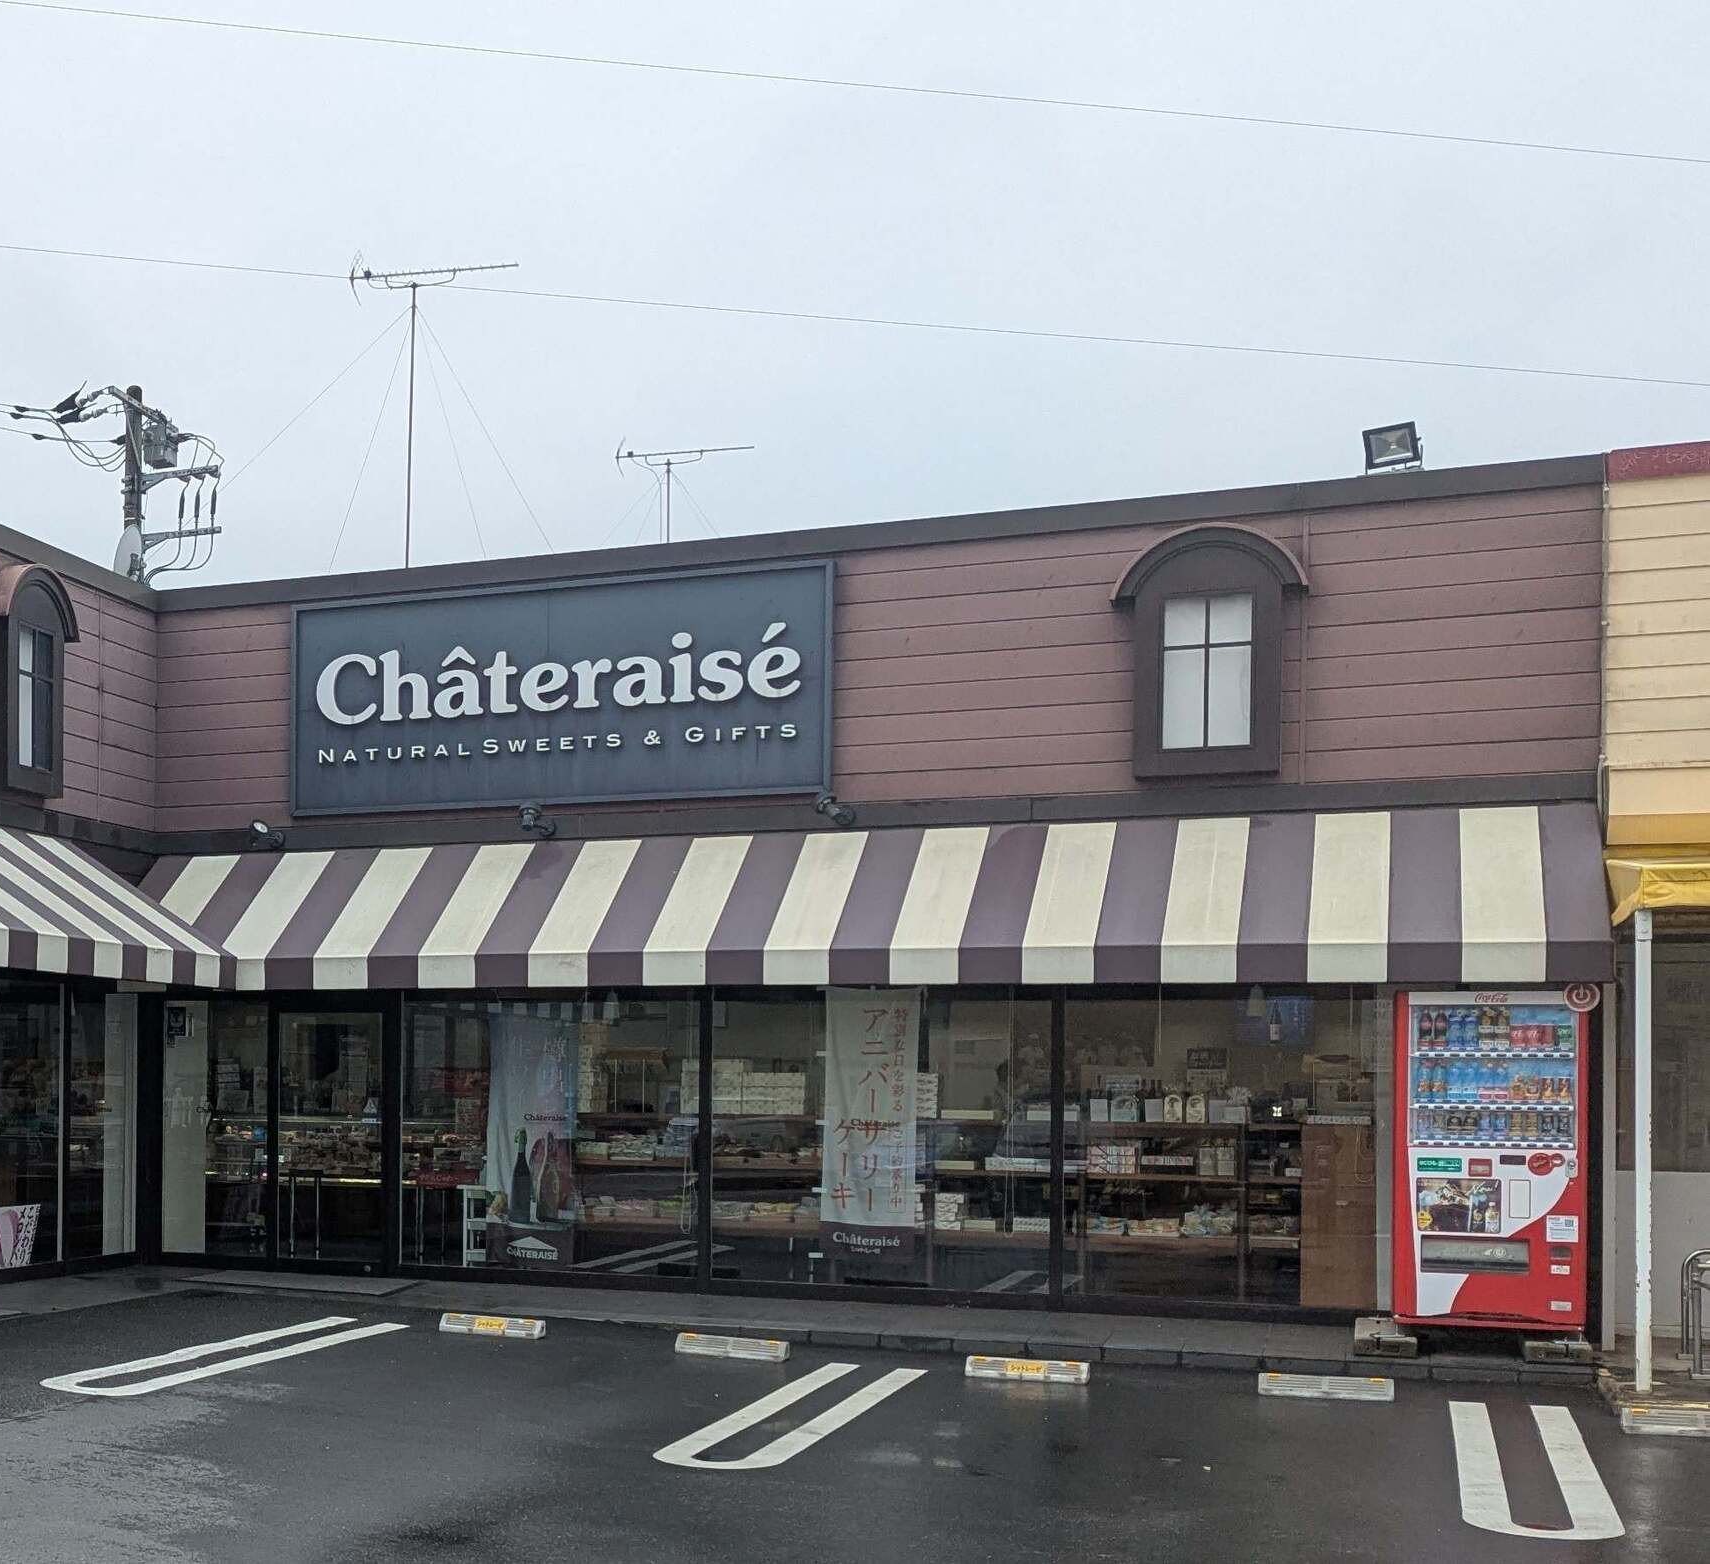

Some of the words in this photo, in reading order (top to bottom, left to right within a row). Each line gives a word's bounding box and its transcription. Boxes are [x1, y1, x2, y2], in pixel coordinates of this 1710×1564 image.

[316, 622, 802, 726] Châteraisé
[318, 742, 471, 764] NATURAL
[482, 733, 622, 755] SWEETS
[644, 729, 661, 746] &
[685, 723, 798, 743] GIFTS
[858, 1008, 890, 1212] アニバーサリー
[833, 1119, 856, 1209] ケーキ
